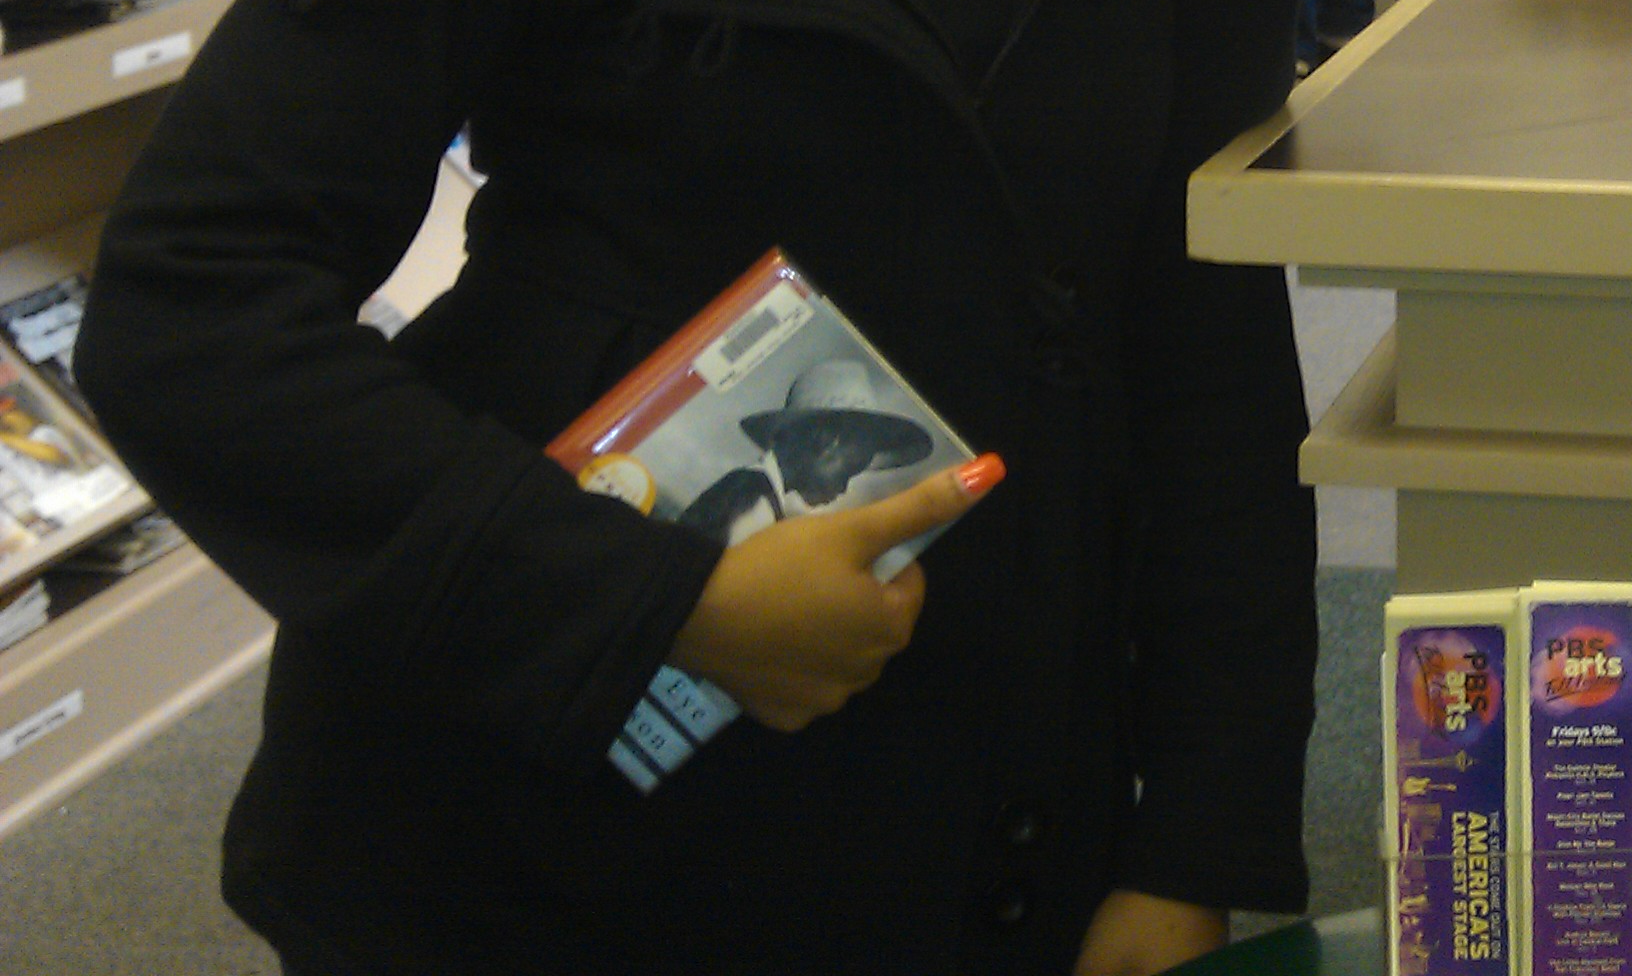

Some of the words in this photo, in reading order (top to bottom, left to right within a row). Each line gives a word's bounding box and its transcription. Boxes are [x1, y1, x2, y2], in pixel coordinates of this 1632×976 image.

[1546, 638, 1605, 660] PBS
[1563, 651, 1623, 678] arts
[1445, 670, 1473, 732] arts
[1463, 651, 1488, 712] PBS
[1452, 810, 1467, 895] LARGEST
[1467, 810, 1490, 961] AMERICA'S
[1453, 898, 1468, 961] STAGE
